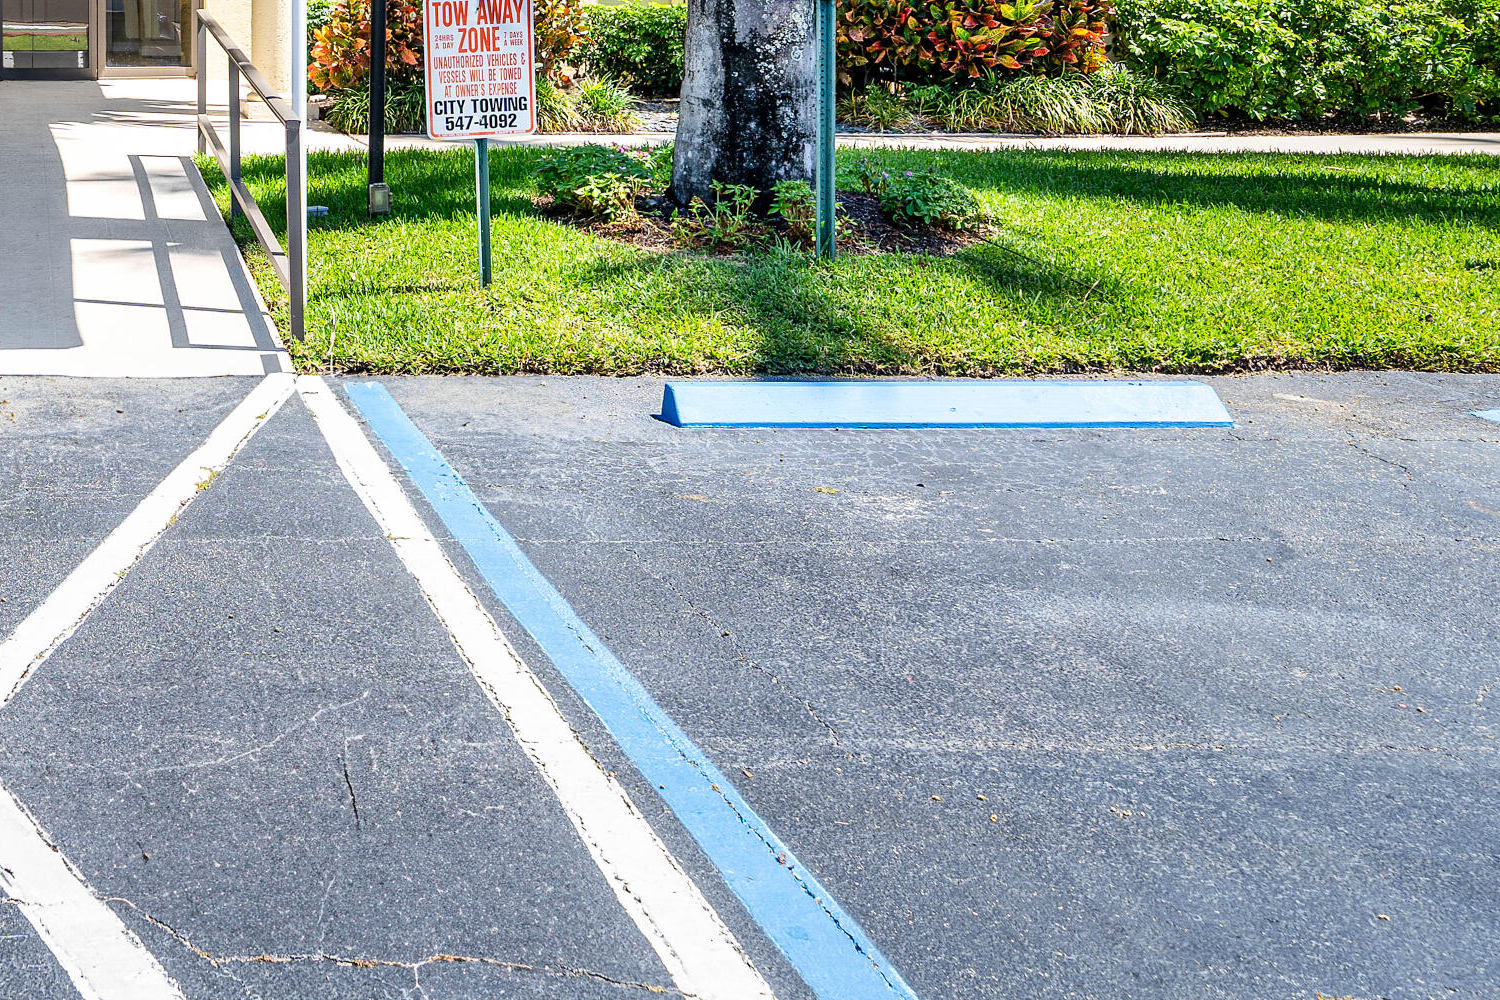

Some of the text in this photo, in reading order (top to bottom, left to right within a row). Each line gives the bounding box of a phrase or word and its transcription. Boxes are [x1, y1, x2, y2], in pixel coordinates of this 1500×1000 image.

[432, 0, 469, 27] TOW
[434, 34, 454, 42] 24HRS
[458, 26, 500, 53] ZONE
[433, 52, 526, 70] UNAUTHORIZED VEHICLES &
[438, 67, 522, 84] VESSELS WILL BE TOWED
[444, 82, 517, 98] AT OWNER'S EXPENSE
[434, 96, 528, 115] CITY TOWING
[445, 113, 518, 131] 547-4092
